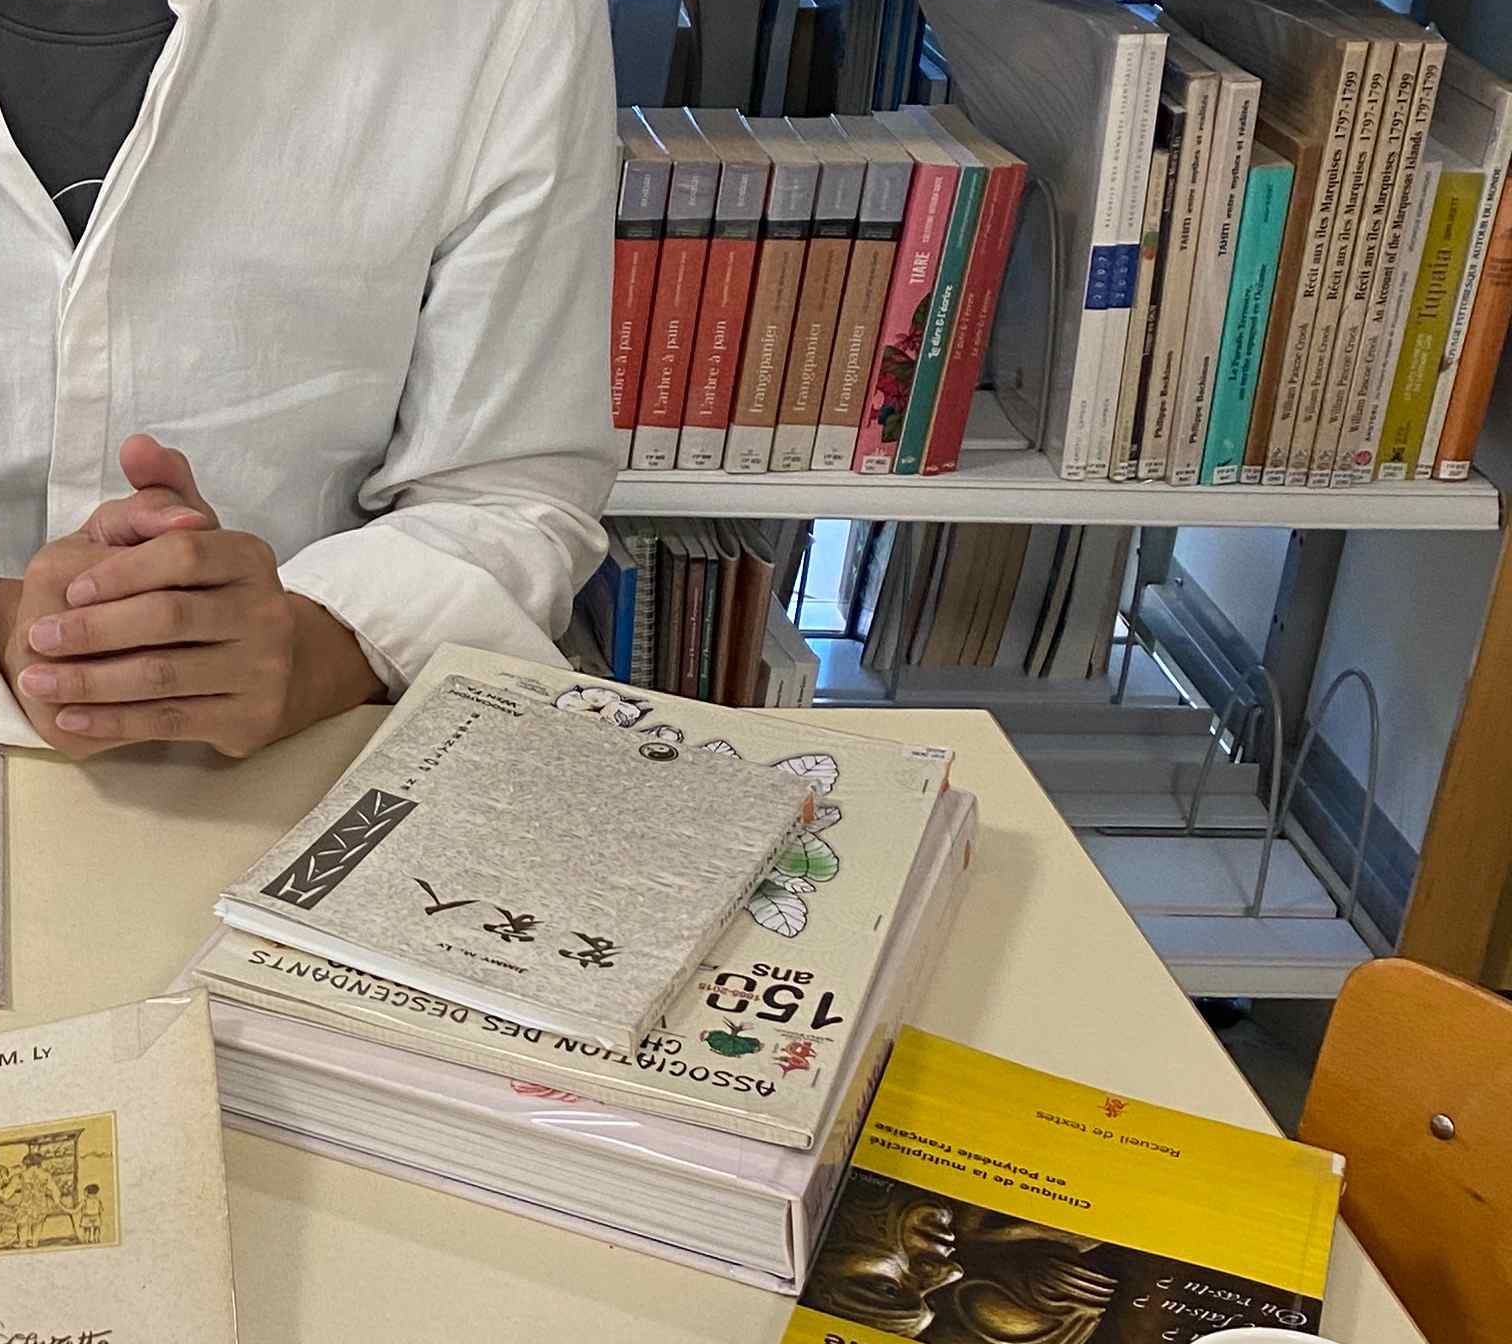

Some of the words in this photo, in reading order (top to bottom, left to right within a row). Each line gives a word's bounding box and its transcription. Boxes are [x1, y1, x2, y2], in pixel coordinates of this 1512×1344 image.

[1334, 71, 1359, 140] 1797-1799
[1322, 147, 1343, 214] Marquises
[1315, 215, 1330, 241] îles
[1313, 241, 1325, 265] aux
[1303, 267, 1320, 298] Récit
[413, 876, 625, 969] 客家人
[247, 949, 471, 1025] DESCENDANTS
[752, 963, 815, 985] ans
[704, 971, 844, 1030] 150
[482, 1014, 544, 1044] DES
[554, 1034, 777, 1097] ASSOCIATION
[1035, 1110, 1088, 1134] textes
[1092, 1127, 1113, 1140] de
[874, 1121, 953, 1156] française
[1119, 1131, 1182, 1161] Recueil
[869, 1136, 968, 1172] multiplicité
[973, 1168, 989, 1181] la
[993, 1173, 1015, 1188] de
[1046, 1176, 1068, 1188] en
[1020, 1181, 1093, 1210] Clinique
